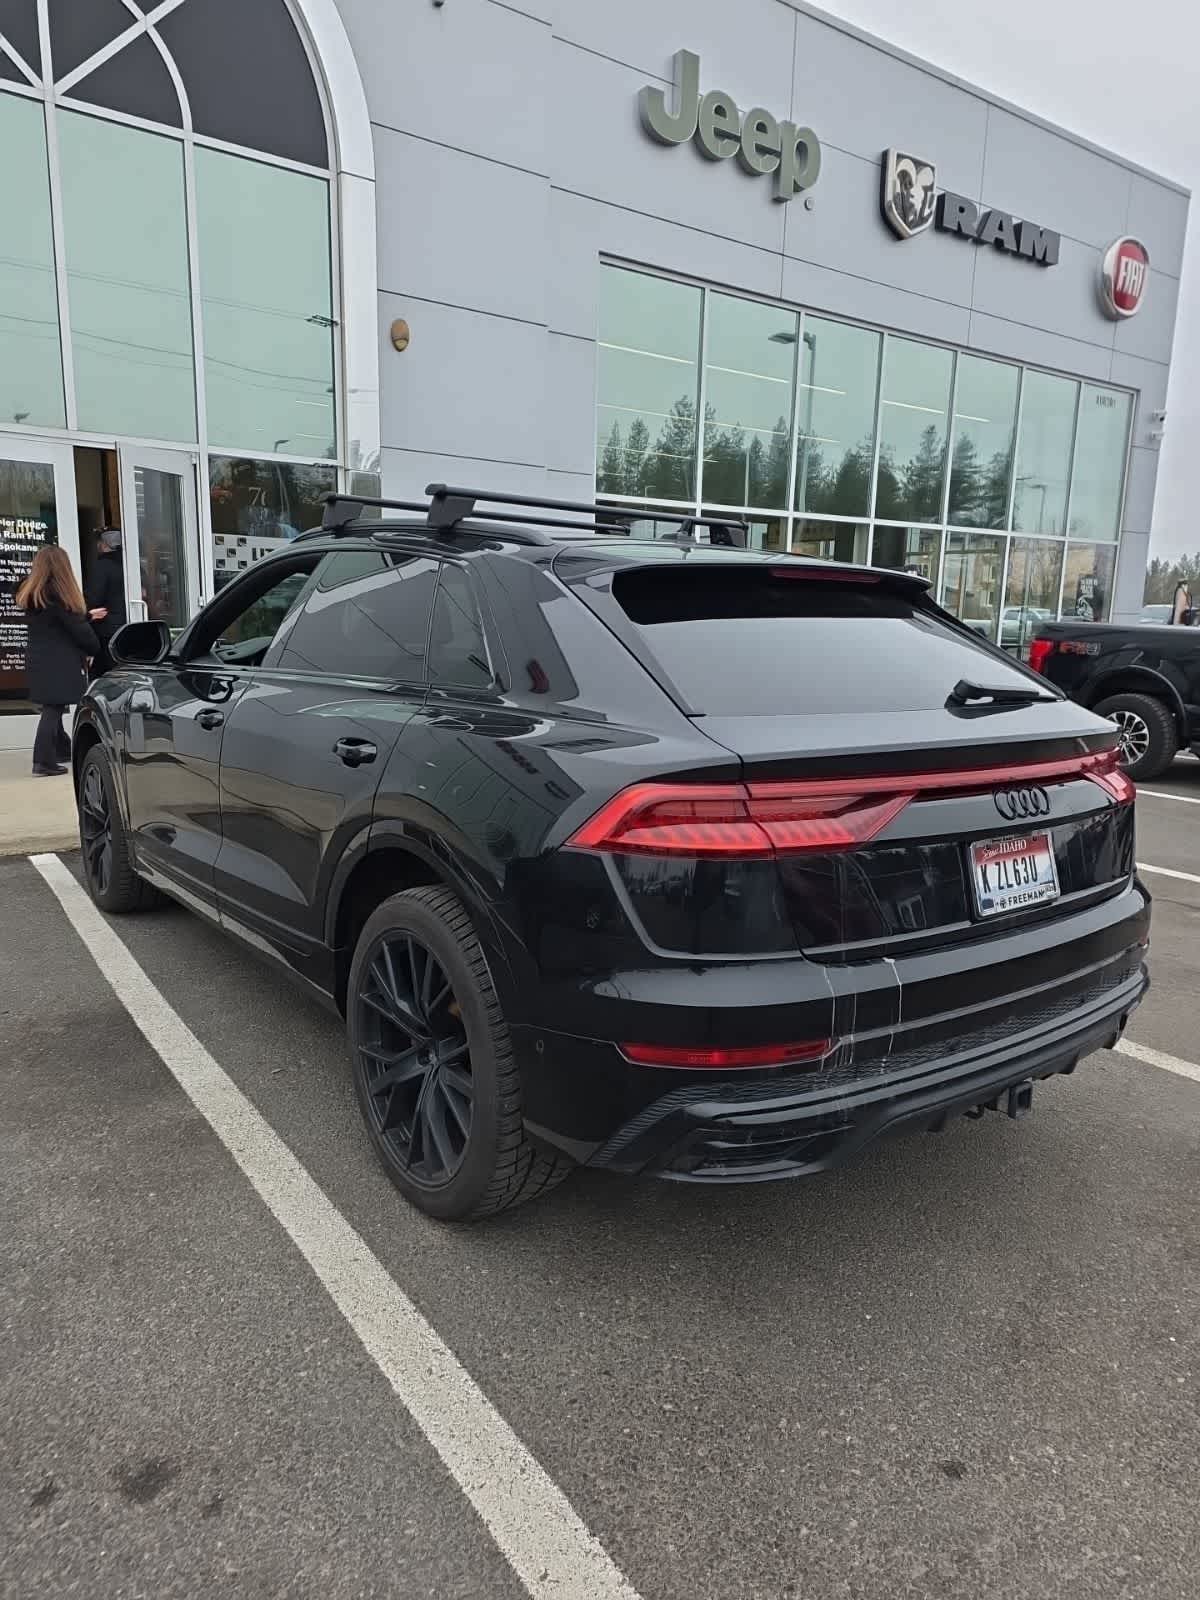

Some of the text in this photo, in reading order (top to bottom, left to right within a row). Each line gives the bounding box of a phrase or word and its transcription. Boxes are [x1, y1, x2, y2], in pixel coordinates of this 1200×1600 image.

[638, 48, 821, 203] Jeep
[935, 190, 1061, 267] RAM
[1115, 255, 1145, 298] FIAT
[4, 530, 25, 540] Ram
[17, 519, 48, 530] Dodge
[999, 839, 1027, 854] IDAHO
[980, 864, 992, 893] K
[1007, 888, 1045, 907] FREEMAN
